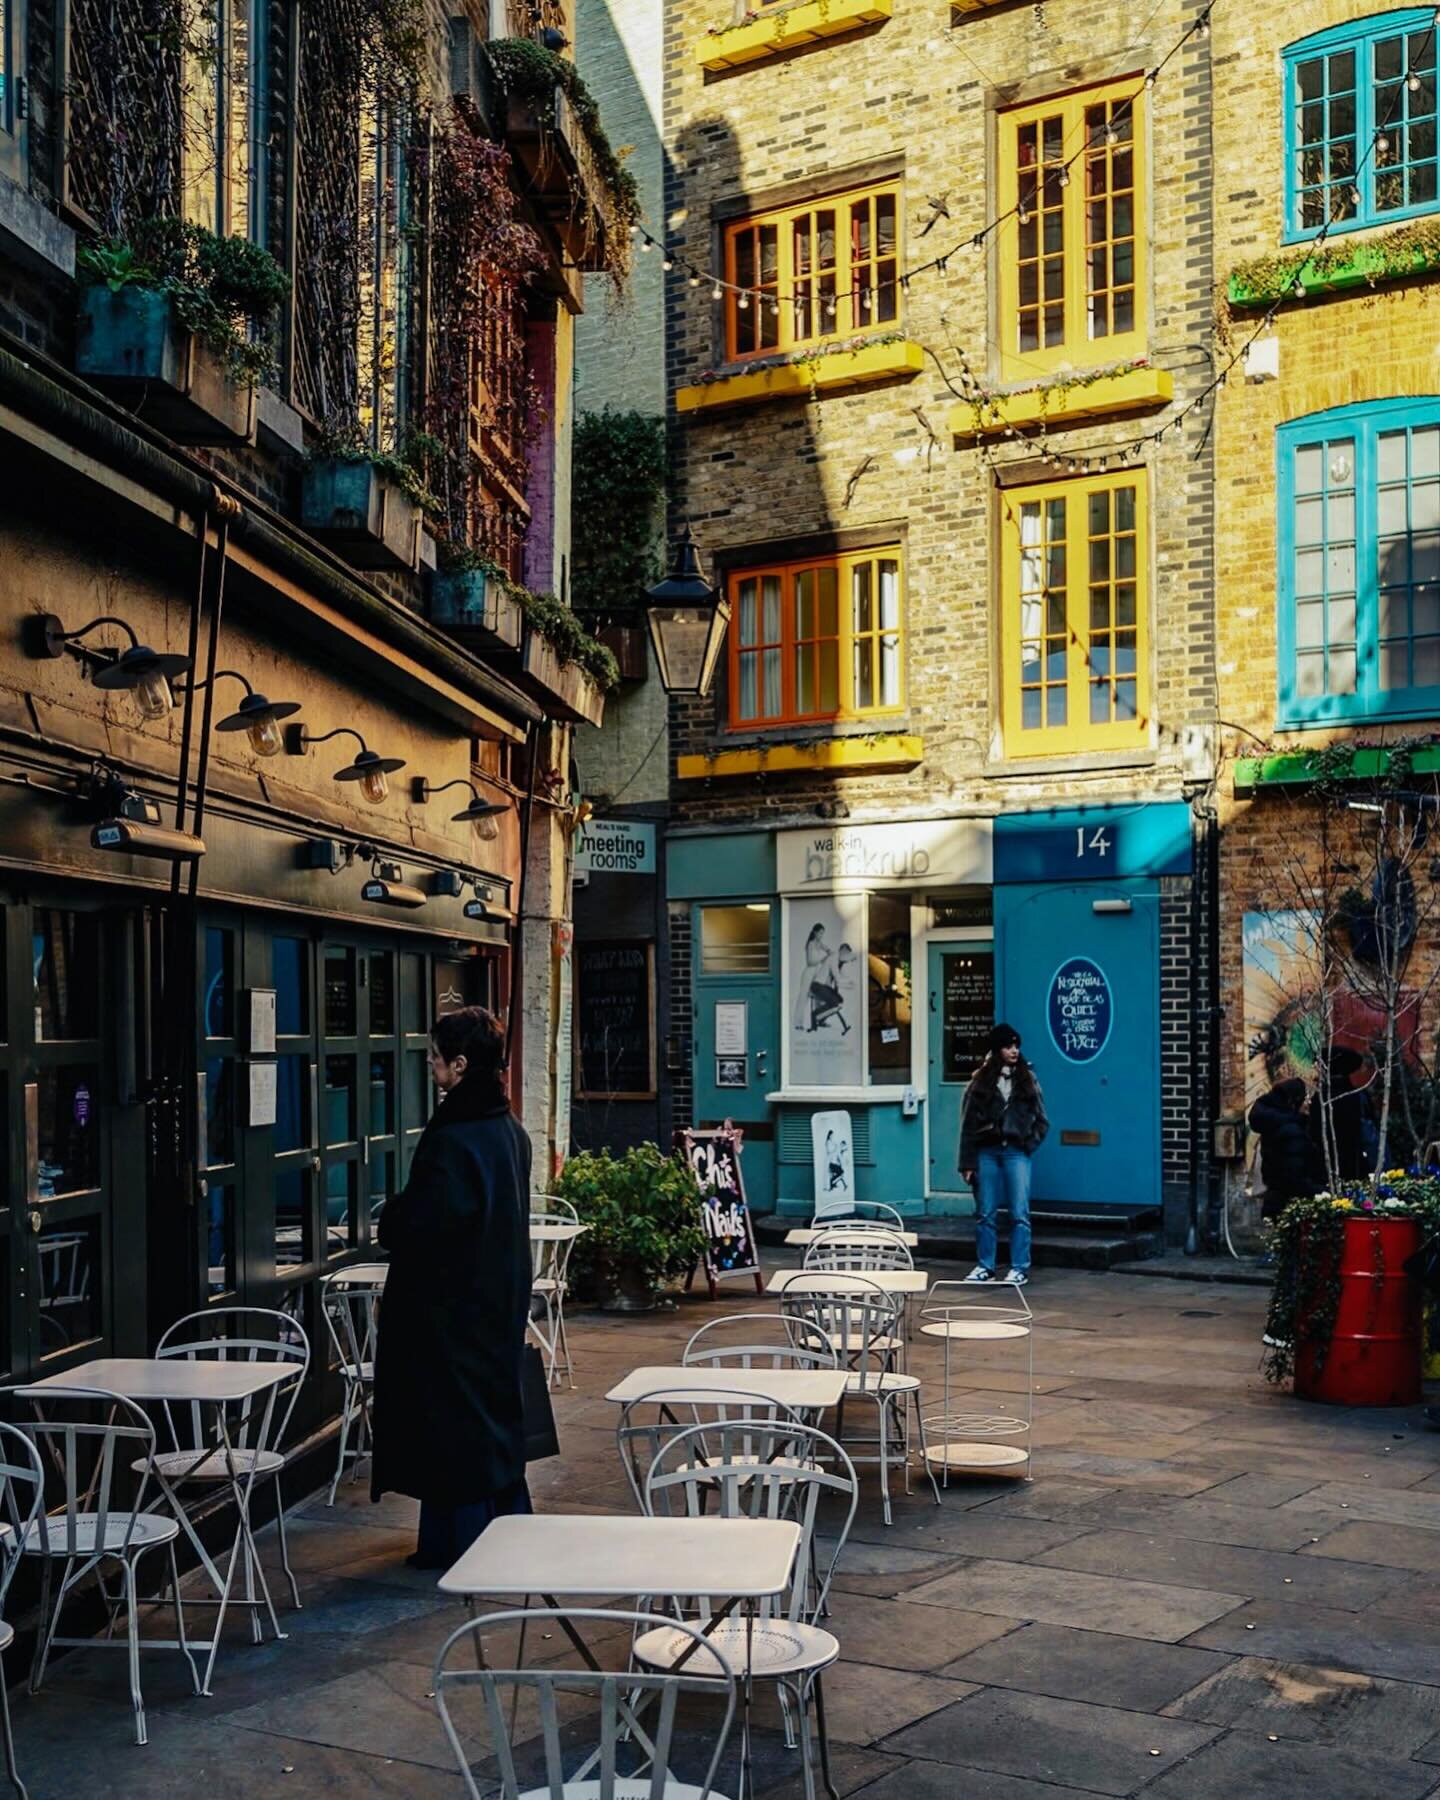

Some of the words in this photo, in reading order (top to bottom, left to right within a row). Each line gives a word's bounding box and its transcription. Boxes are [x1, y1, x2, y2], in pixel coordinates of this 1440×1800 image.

[582, 833, 645, 859] meeting
[814, 833, 862, 851] walk-in
[1077, 826, 1111, 858] 14
[590, 853, 637, 870] rooms
[805, 841, 930, 880] backrub
[702, 1201, 746, 1239] Nails
